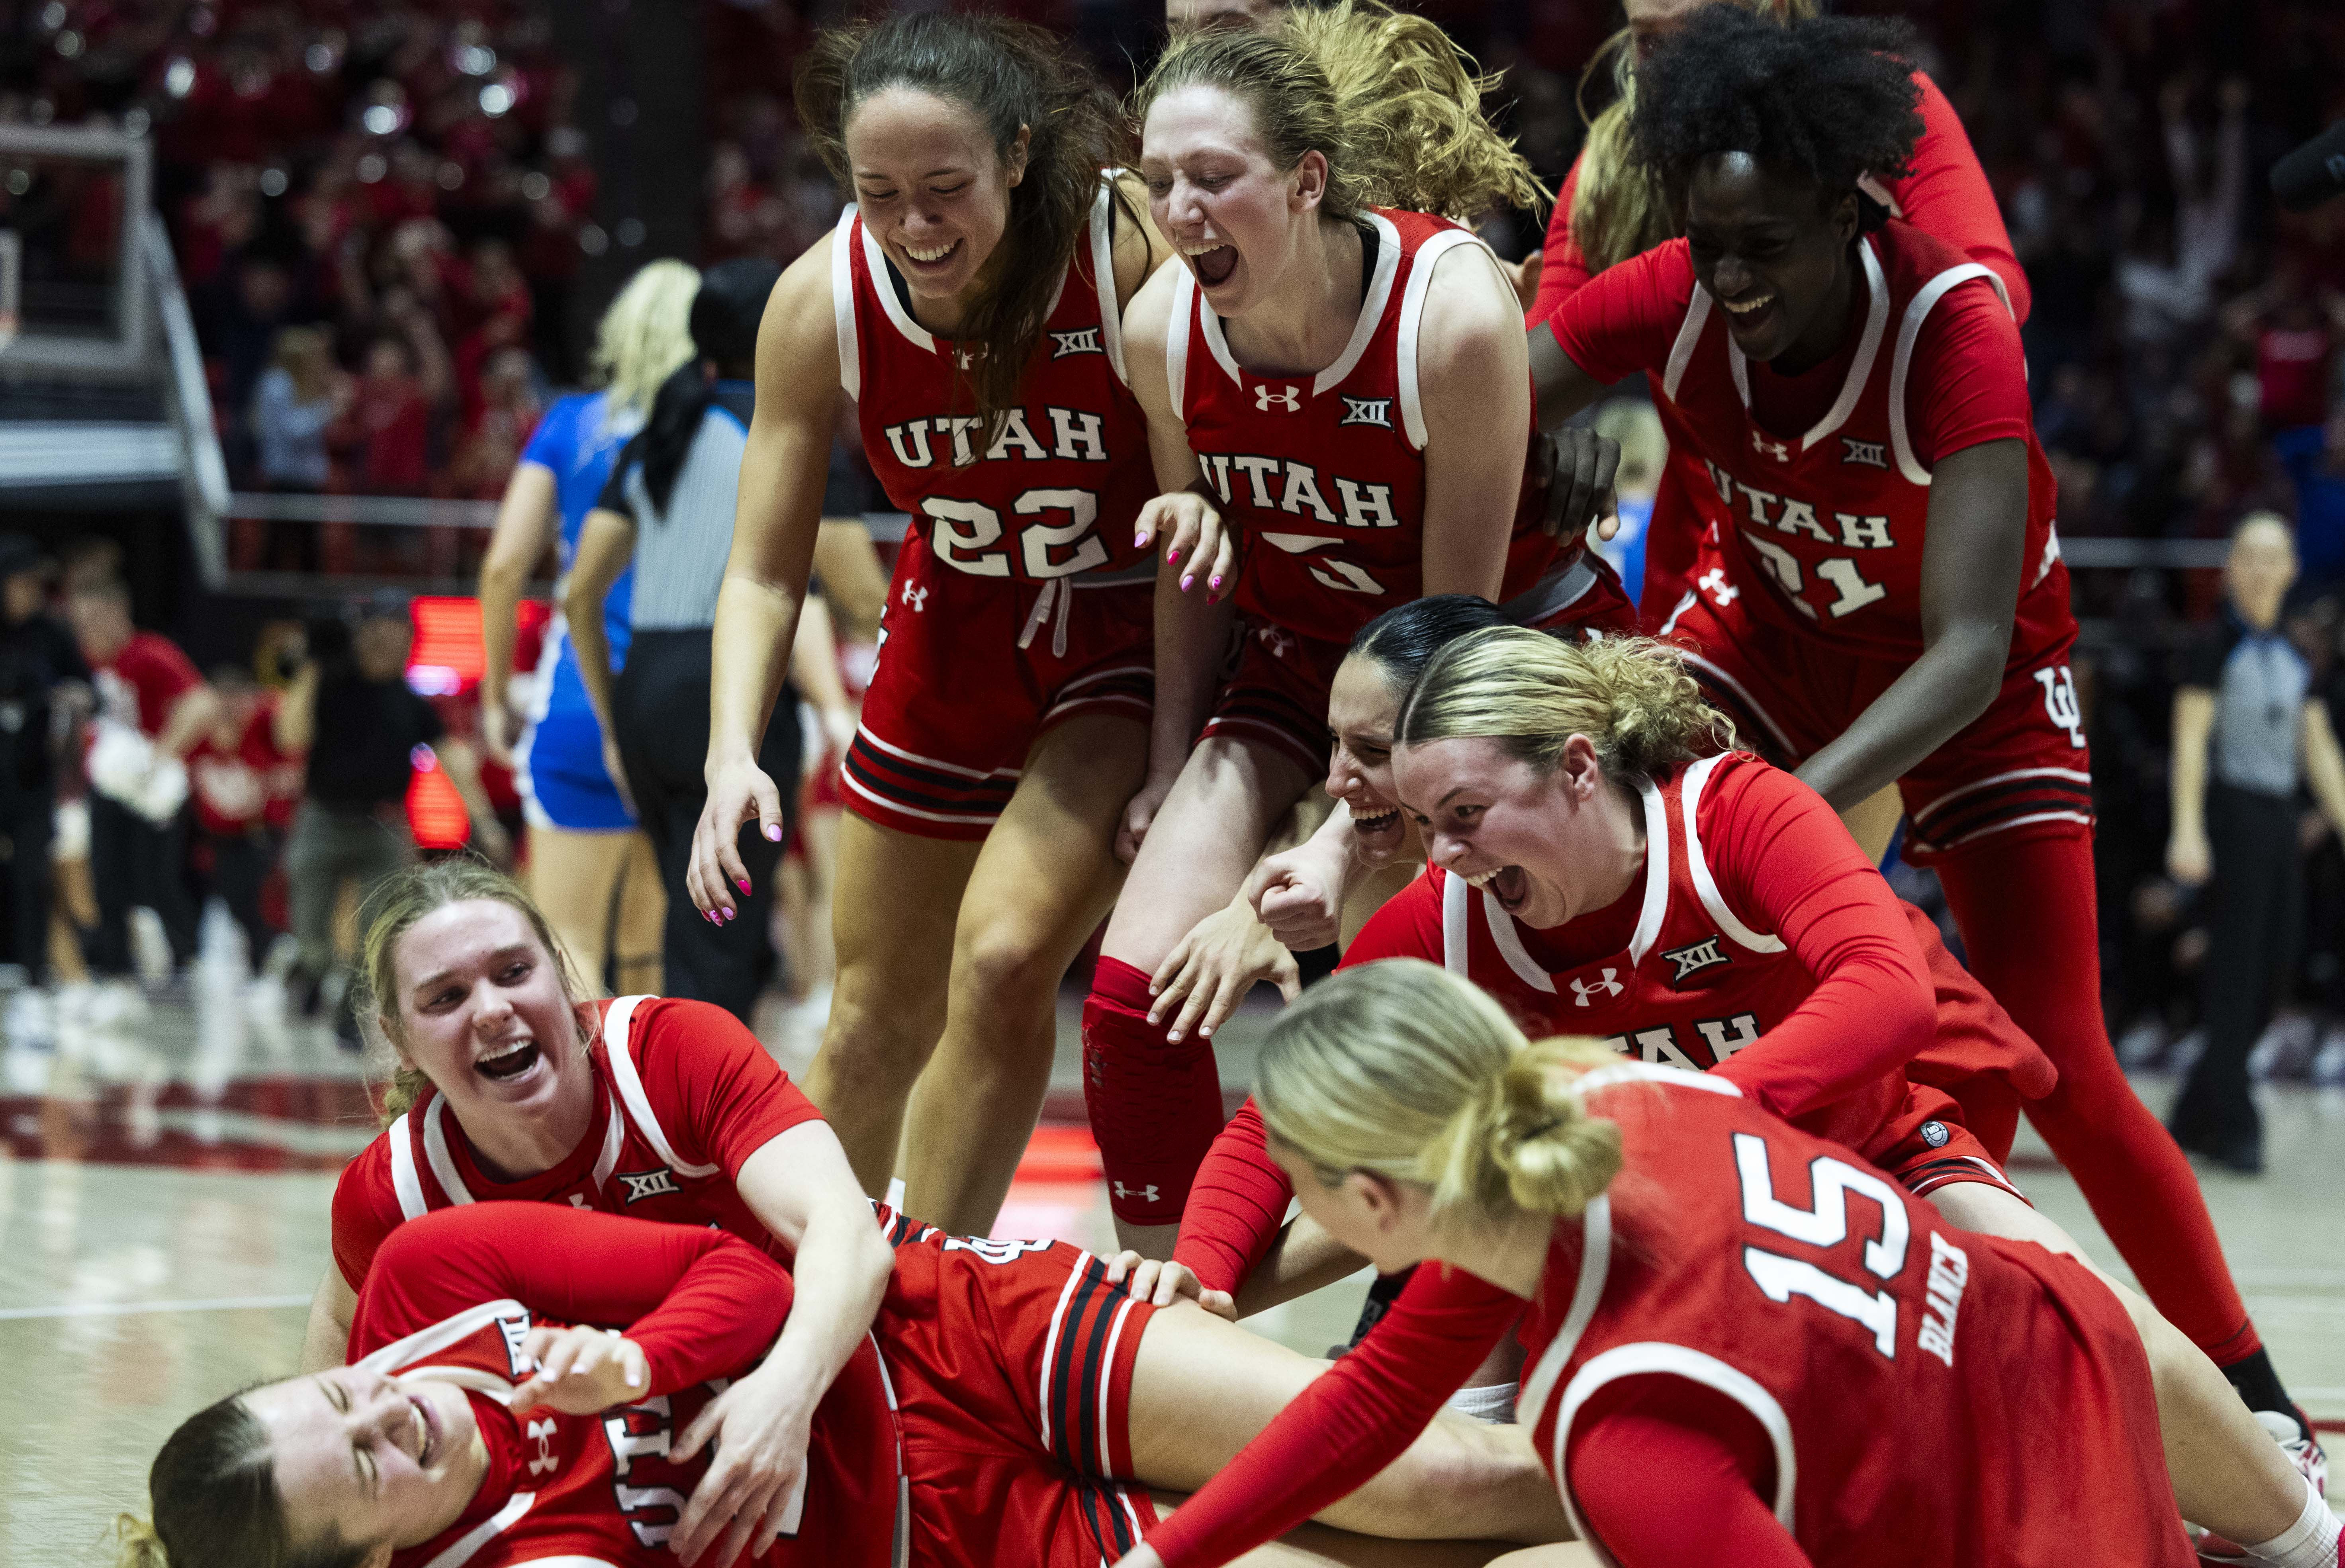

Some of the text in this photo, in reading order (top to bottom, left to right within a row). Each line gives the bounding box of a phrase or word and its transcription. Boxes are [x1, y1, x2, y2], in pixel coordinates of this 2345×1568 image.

[1050, 327, 1104, 358] XII
[886, 407, 1108, 468] UTAH
[1341, 397, 1392, 428] XII
[1842, 439, 1889, 469] XII
[1198, 454, 1399, 527] UTAH
[1705, 458, 1894, 548] UTAH
[920, 489, 1108, 577] 22
[1665, 936, 1728, 981] XII
[620, 1170, 680, 1202] XII
[1733, 1133, 1909, 1359] 15
[1918, 1230, 1968, 1367] BLANC
